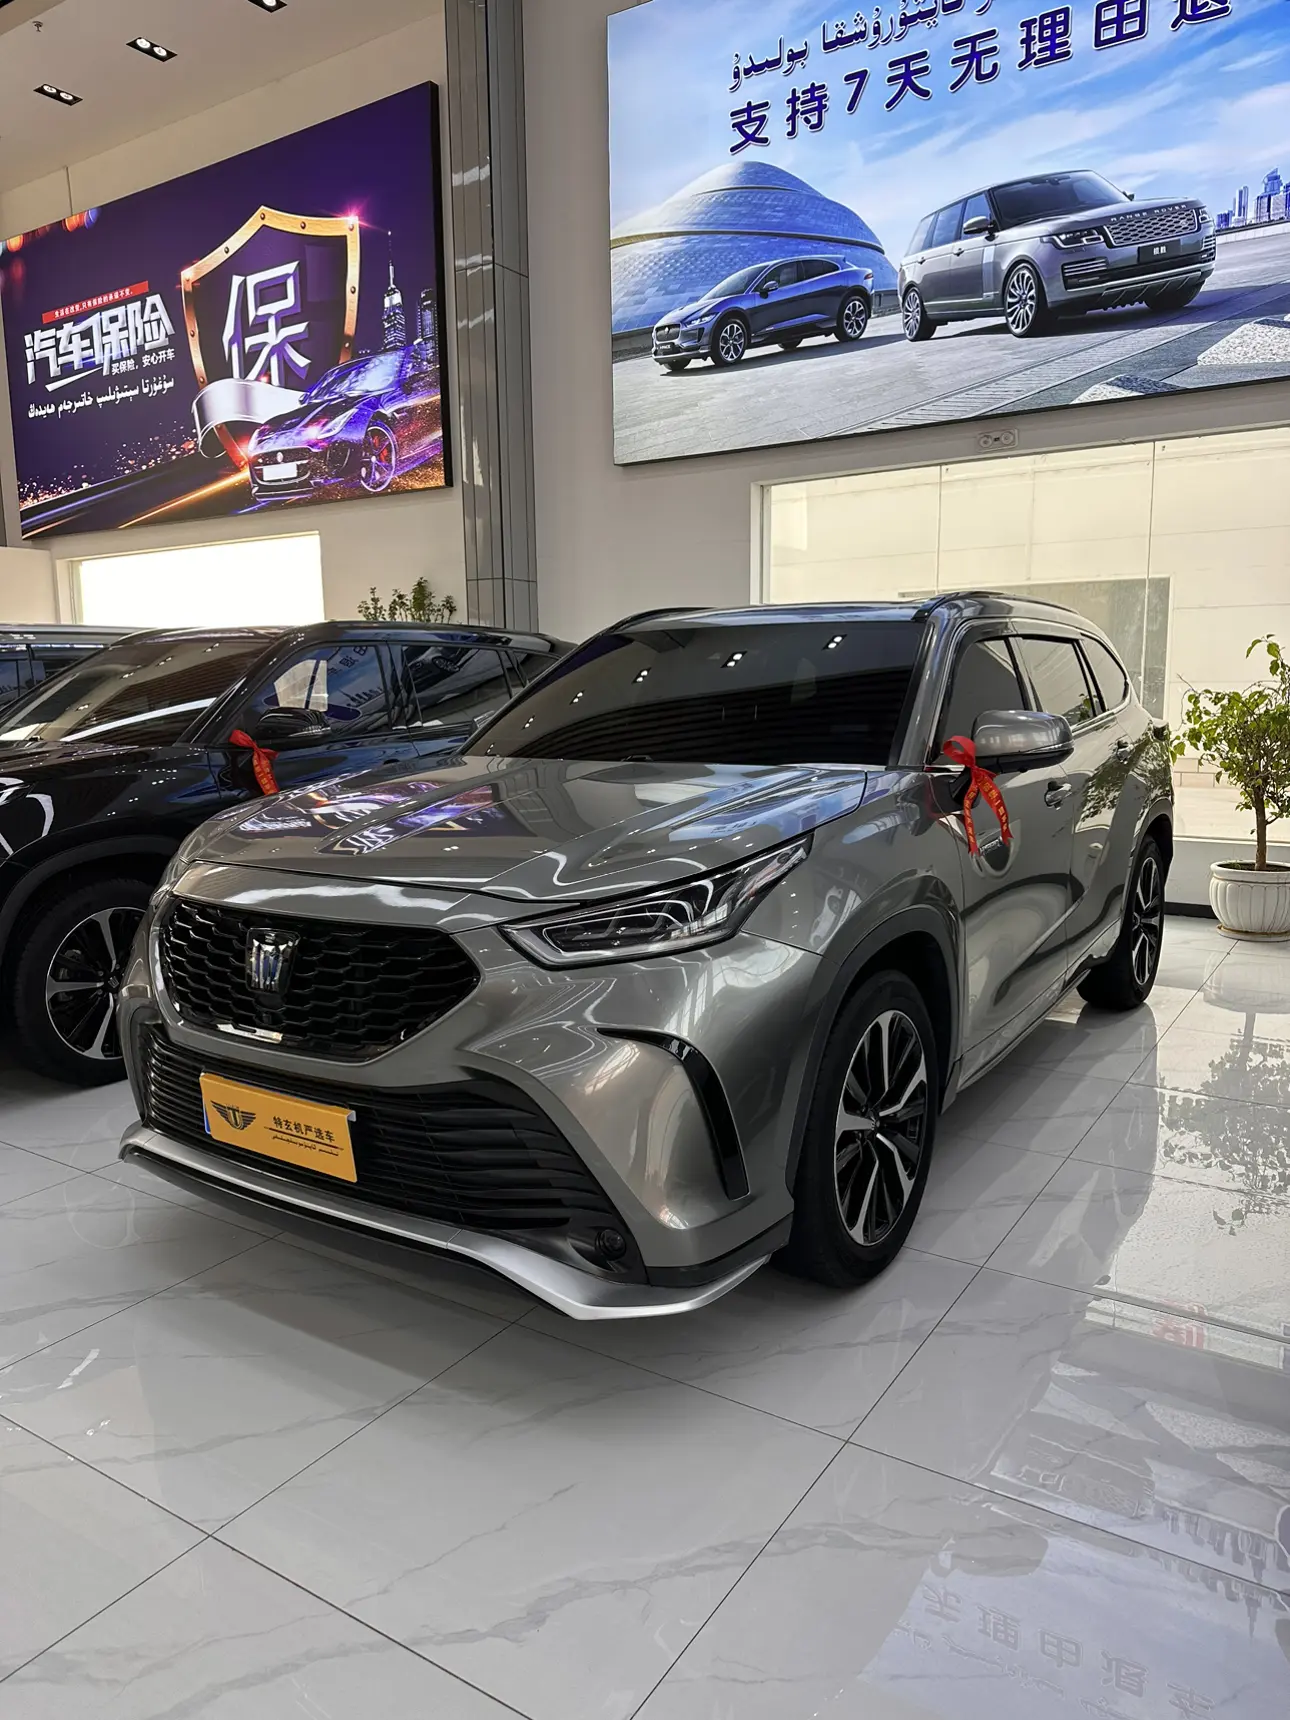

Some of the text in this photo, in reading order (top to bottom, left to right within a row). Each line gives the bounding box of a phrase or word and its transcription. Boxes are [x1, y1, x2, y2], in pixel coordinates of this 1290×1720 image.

[24, 293, 175, 385] 汽车保险
[222, 260, 311, 385] 保
